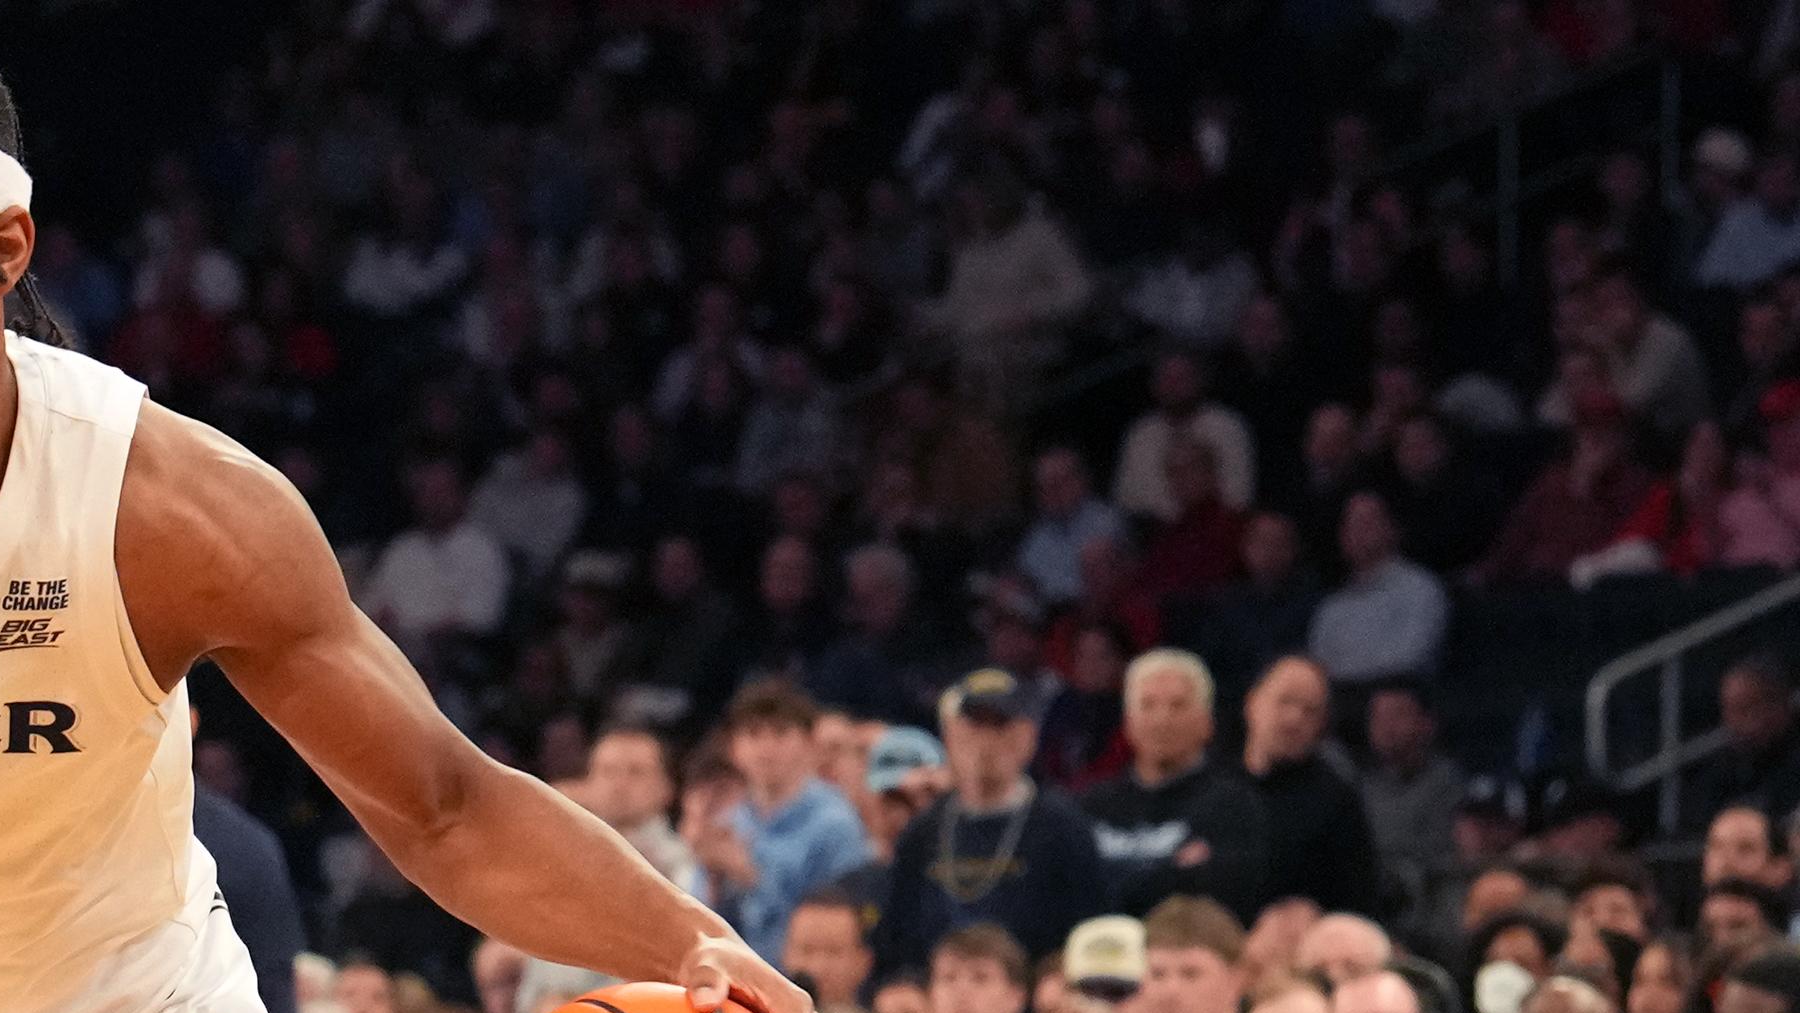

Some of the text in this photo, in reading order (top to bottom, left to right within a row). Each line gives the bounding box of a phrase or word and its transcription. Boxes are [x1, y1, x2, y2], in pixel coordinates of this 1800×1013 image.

[9, 579, 68, 596] BE THE
[2, 594, 70, 611] CHANGE
[0, 617, 54, 634] BIG
